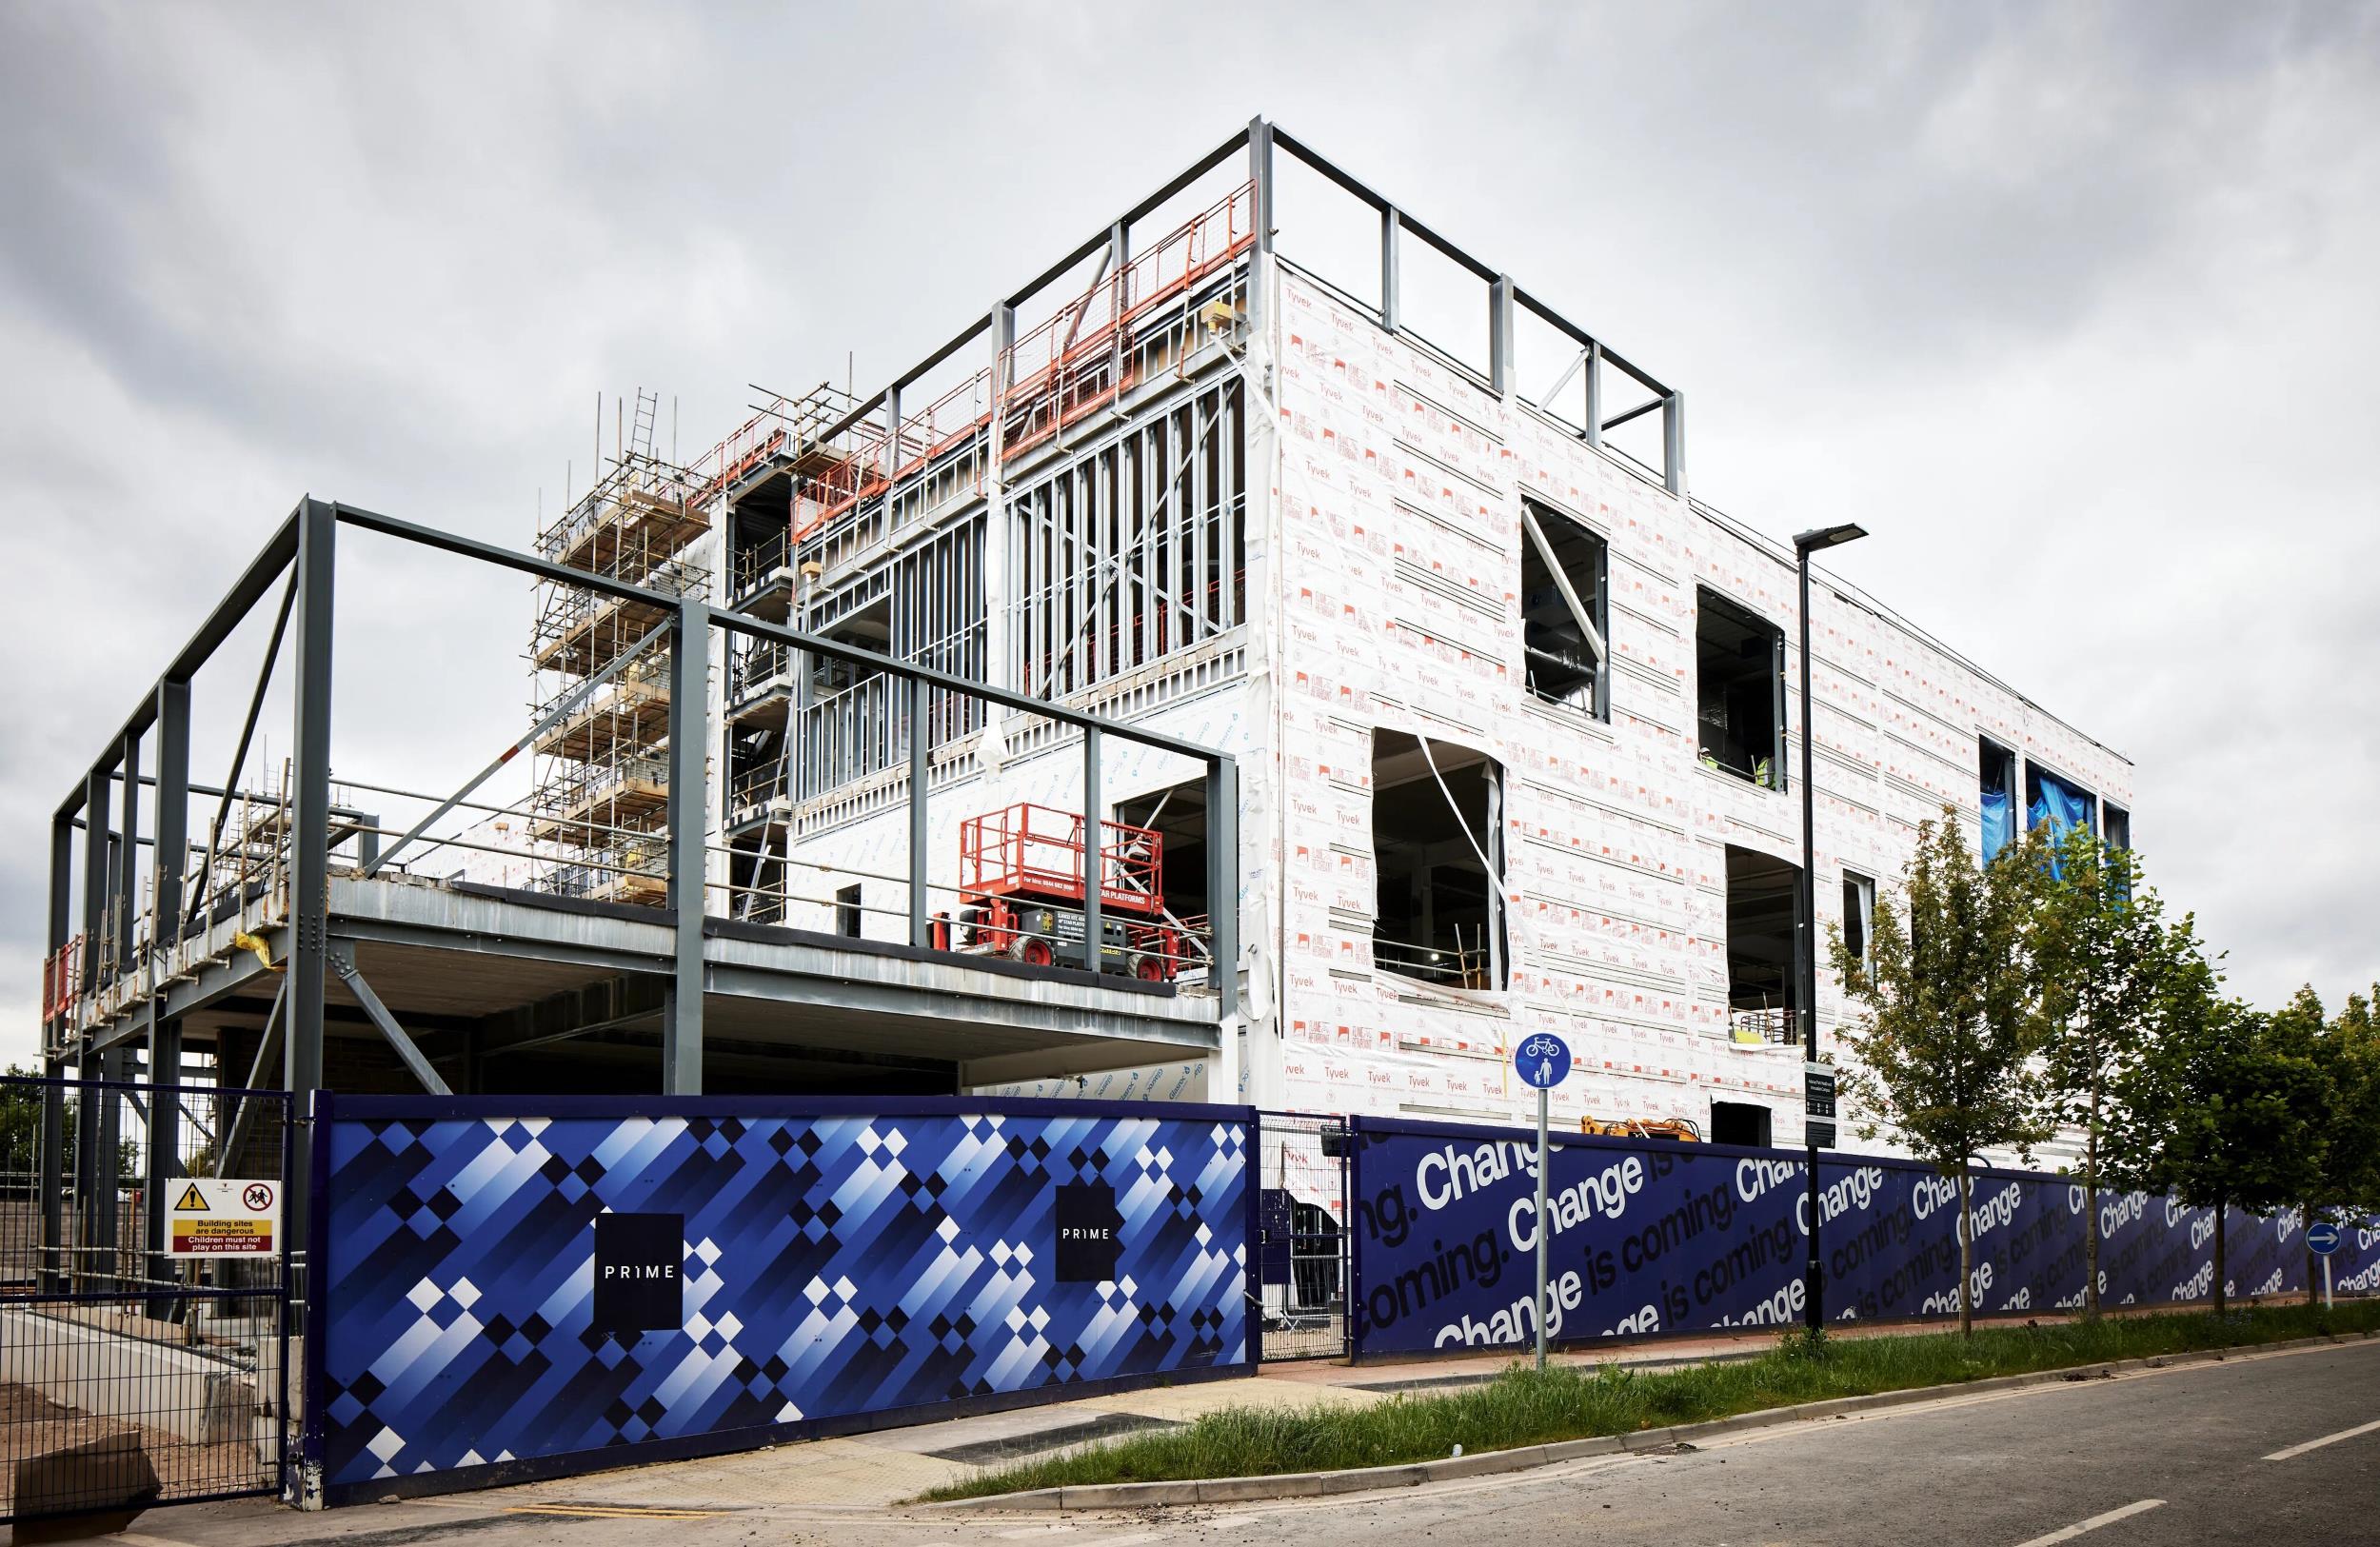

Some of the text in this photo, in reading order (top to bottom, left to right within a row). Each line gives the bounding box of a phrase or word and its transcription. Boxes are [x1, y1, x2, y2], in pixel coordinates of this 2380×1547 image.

[1286, 288, 1312, 308] Tyvek
[1331, 312, 1354, 333] Tyvek
[1371, 336, 1394, 358] Tyvek
[1410, 360, 1432, 379] Tyvek
[1319, 382, 1343, 403] Tyvek
[1447, 381, 1469, 399] Tyvek
[1362, 406, 1384, 425] Tyvek
[1401, 426, 1423, 444] Tyvek
[1438, 446, 1460, 464] Tyvek
[1306, 461, 1330, 480] Tyvek
[1476, 466, 1495, 483] Tyvek
[1349, 481, 1372, 499] Tyvek
[1296, 542, 1320, 560] Tyvek
[1380, 577, 1403, 594] Tyvek
[1420, 593, 1441, 610] Tyvek
[1458, 609, 1478, 625] Tyvek
[1292, 625, 1318, 643] Tyvek
[1494, 625, 1515, 639] Tyvek
[1336, 641, 1359, 658] Tyvek
[1378, 656, 1399, 672] Tyek
[1418, 671, 1439, 686] Tyvek
[1456, 684, 1476, 701] Tyvek
[1315, 719, 1338, 736] Tyvek
[1292, 799, 1317, 815] Tyvek
[1336, 809, 1359, 825] Tyvek
[1536, 863, 1554, 876] Tyvek
[1569, 871, 1586, 883] Tyvek
[1598, 879, 1616, 891] Tyvek
[1111, 890, 1145, 904] PLATFORMS
[1293, 886, 1319, 901] Tyvek
[1629, 887, 1645, 899] Tyvek
[1656, 895, 1673, 906] Tyvek
[1338, 895, 1361, 910] Tyvek
[1539, 939, 1558, 950] Tyvek
[1572, 945, 1590, 957] Tyvek
[1603, 952, 1619, 963] Tyvek
[1632, 958, 1648, 969] Tyvek
[1660, 964, 1676, 976] Tyvek
[1289, 974, 1314, 990] Tyvek
[1333, 981, 1358, 996] Tyvek
[1376, 987, 1398, 1002] Tyvek
[1538, 1014, 1557, 1024] Tyvek
[1601, 1023, 1617, 1035] Tyvek
[1631, 1028, 1647, 1039] Tyvek
[1659, 1033, 1676, 1044] Tyvek
[1324, 1066, 1349, 1081] Tyvek
[1368, 1070, 1391, 1084] Tyvek
[1408, 1075, 1430, 1090] Tyvek
[1446, 1080, 1467, 1095] Tyvek
[1483, 1083, 1502, 1096] Tyvek
[1552, 1091, 1570, 1103] Tyvek
[1584, 1094, 1601, 1106] Tyvek
[1643, 1101, 1659, 1112] Tyvek
[1508, 1156, 1643, 1252] Change
[197, 1220, 231, 1228] Building
[210, 1227, 254, 1236] dangerous
[1062, 1228, 1109, 1240] PRIME
[1584, 1245, 1616, 1296] is
[1622, 1181, 1737, 1273] coming.
[192, 1243, 210, 1252] play
[605, 1265, 674, 1279] PRIME
[1662, 1279, 1689, 1327] is
[1695, 1217, 1797, 1305] coming.
[1922, 1261, 1993, 1316] hage
[1710, 1278, 1806, 1328] ange
